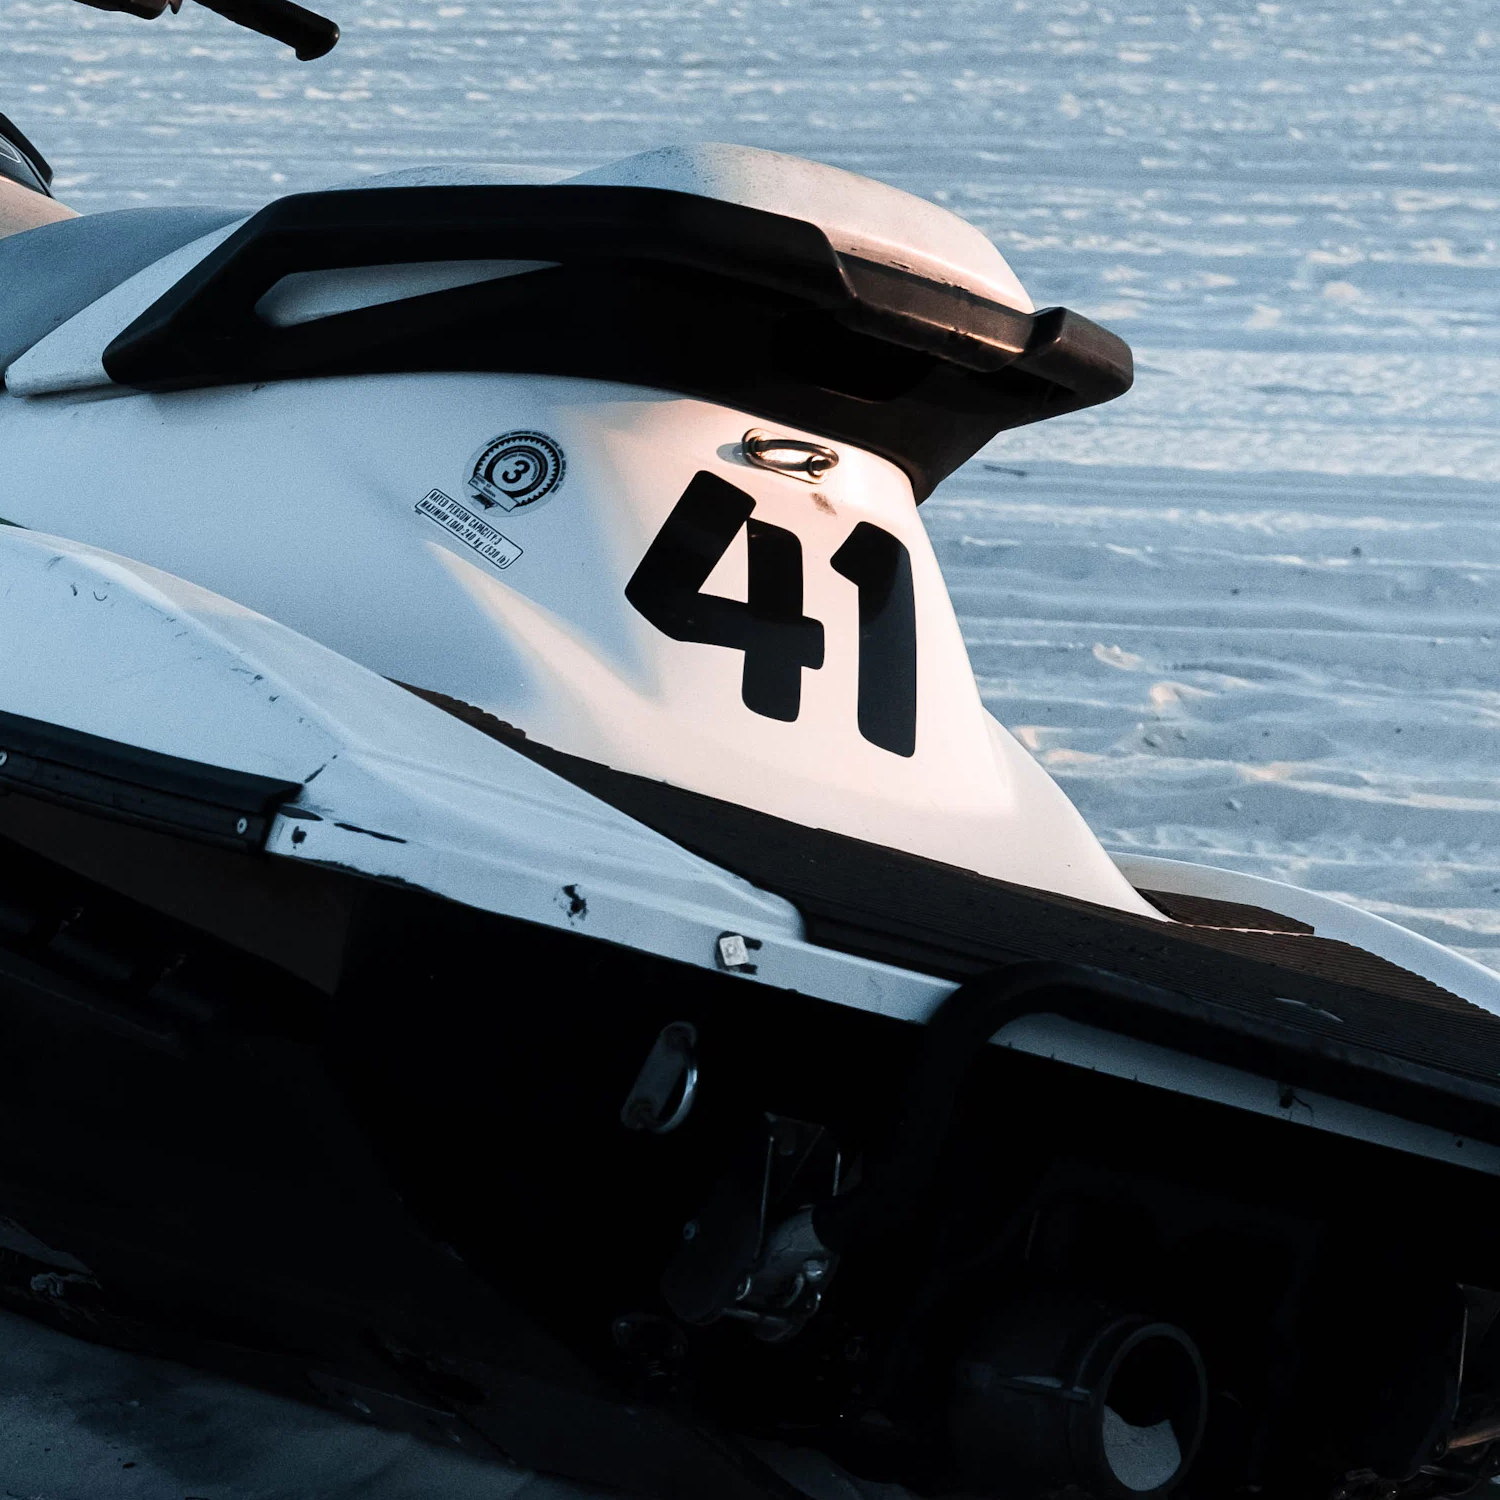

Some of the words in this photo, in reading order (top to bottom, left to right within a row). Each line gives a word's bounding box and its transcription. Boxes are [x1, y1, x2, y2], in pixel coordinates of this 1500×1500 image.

[502, 460, 531, 484] 3
[420, 500, 449, 522] MAXIMUM
[473, 537, 484, 549] kg
[429, 491, 449, 510] RATED
[446, 503, 471, 524] PERSON
[624, 469, 917, 758] 41
